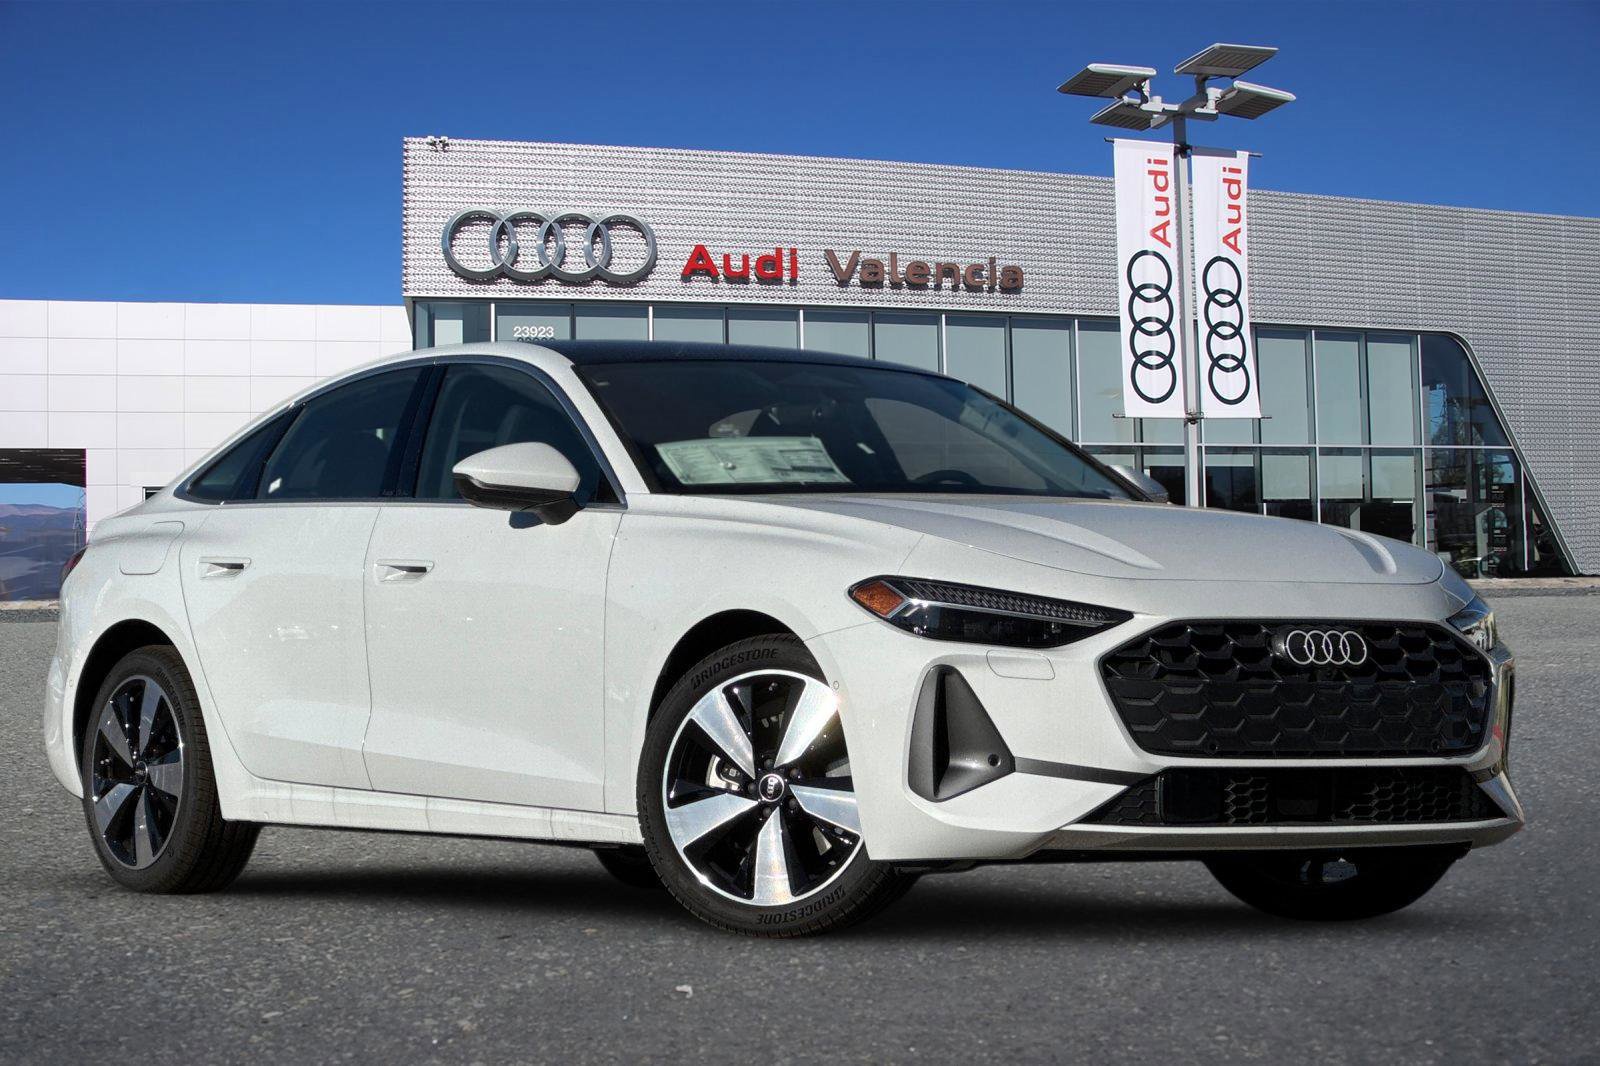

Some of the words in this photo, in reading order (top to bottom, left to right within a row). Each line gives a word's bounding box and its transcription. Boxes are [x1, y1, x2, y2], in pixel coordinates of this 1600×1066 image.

[1146, 158, 1172, 249] Audi
[1222, 166, 1242, 256] Audi
[680, 244, 798, 283] Audi
[824, 249, 1024, 289] Valencia
[513, 326, 555, 338] 23923
[690, 647, 779, 690] BRIDGESTONE
[755, 885, 847, 925] BRIDGESTONE
